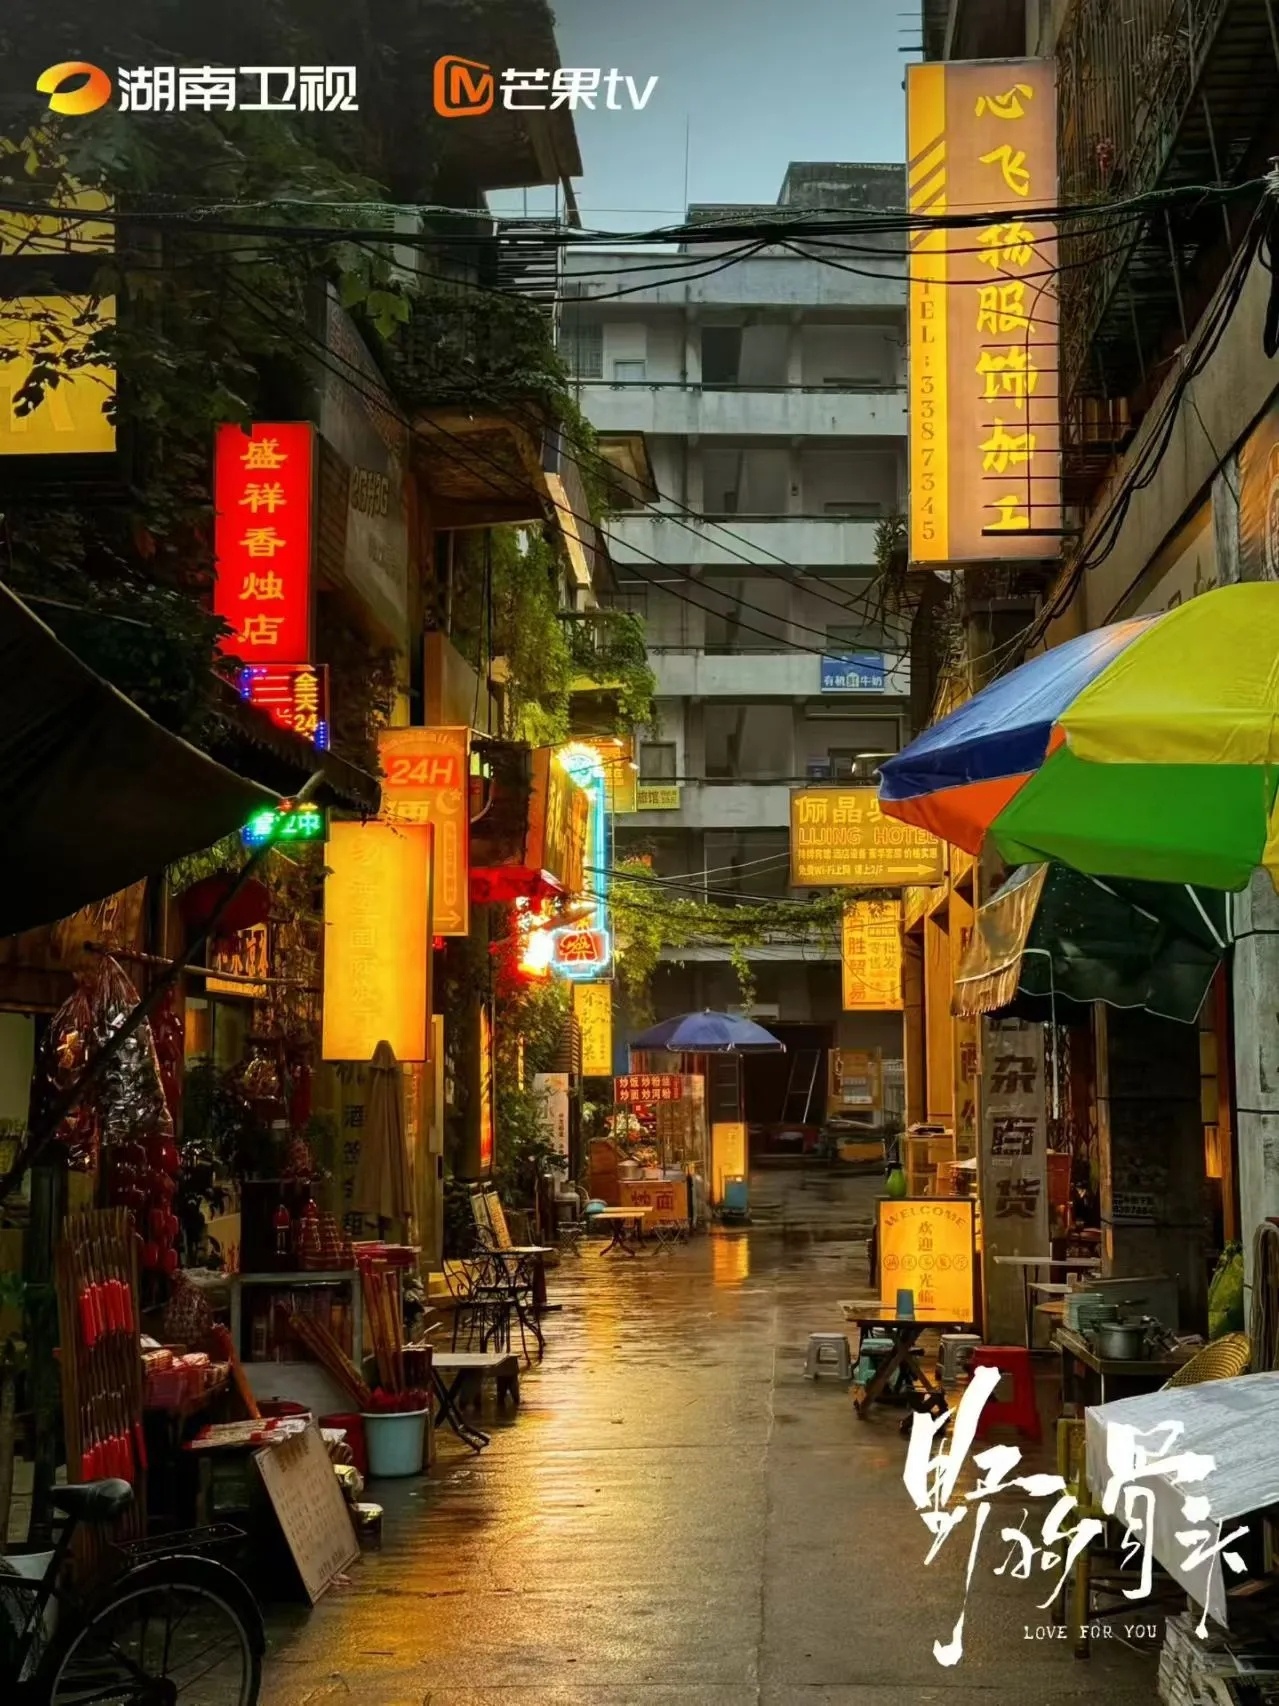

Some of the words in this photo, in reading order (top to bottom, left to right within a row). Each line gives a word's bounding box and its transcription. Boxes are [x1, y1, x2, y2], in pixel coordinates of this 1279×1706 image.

[238, 438, 288, 647] 盛祥香烛店
[388, 759, 455, 785] 24H
[798, 826, 863, 846] LIJING
[873, 826, 939, 845] HOTEL
[989, 1018, 1040, 1219] 杂百货
[884, 1205, 967, 1230] WELCOME
[918, 1220, 934, 1252] 欢迎
